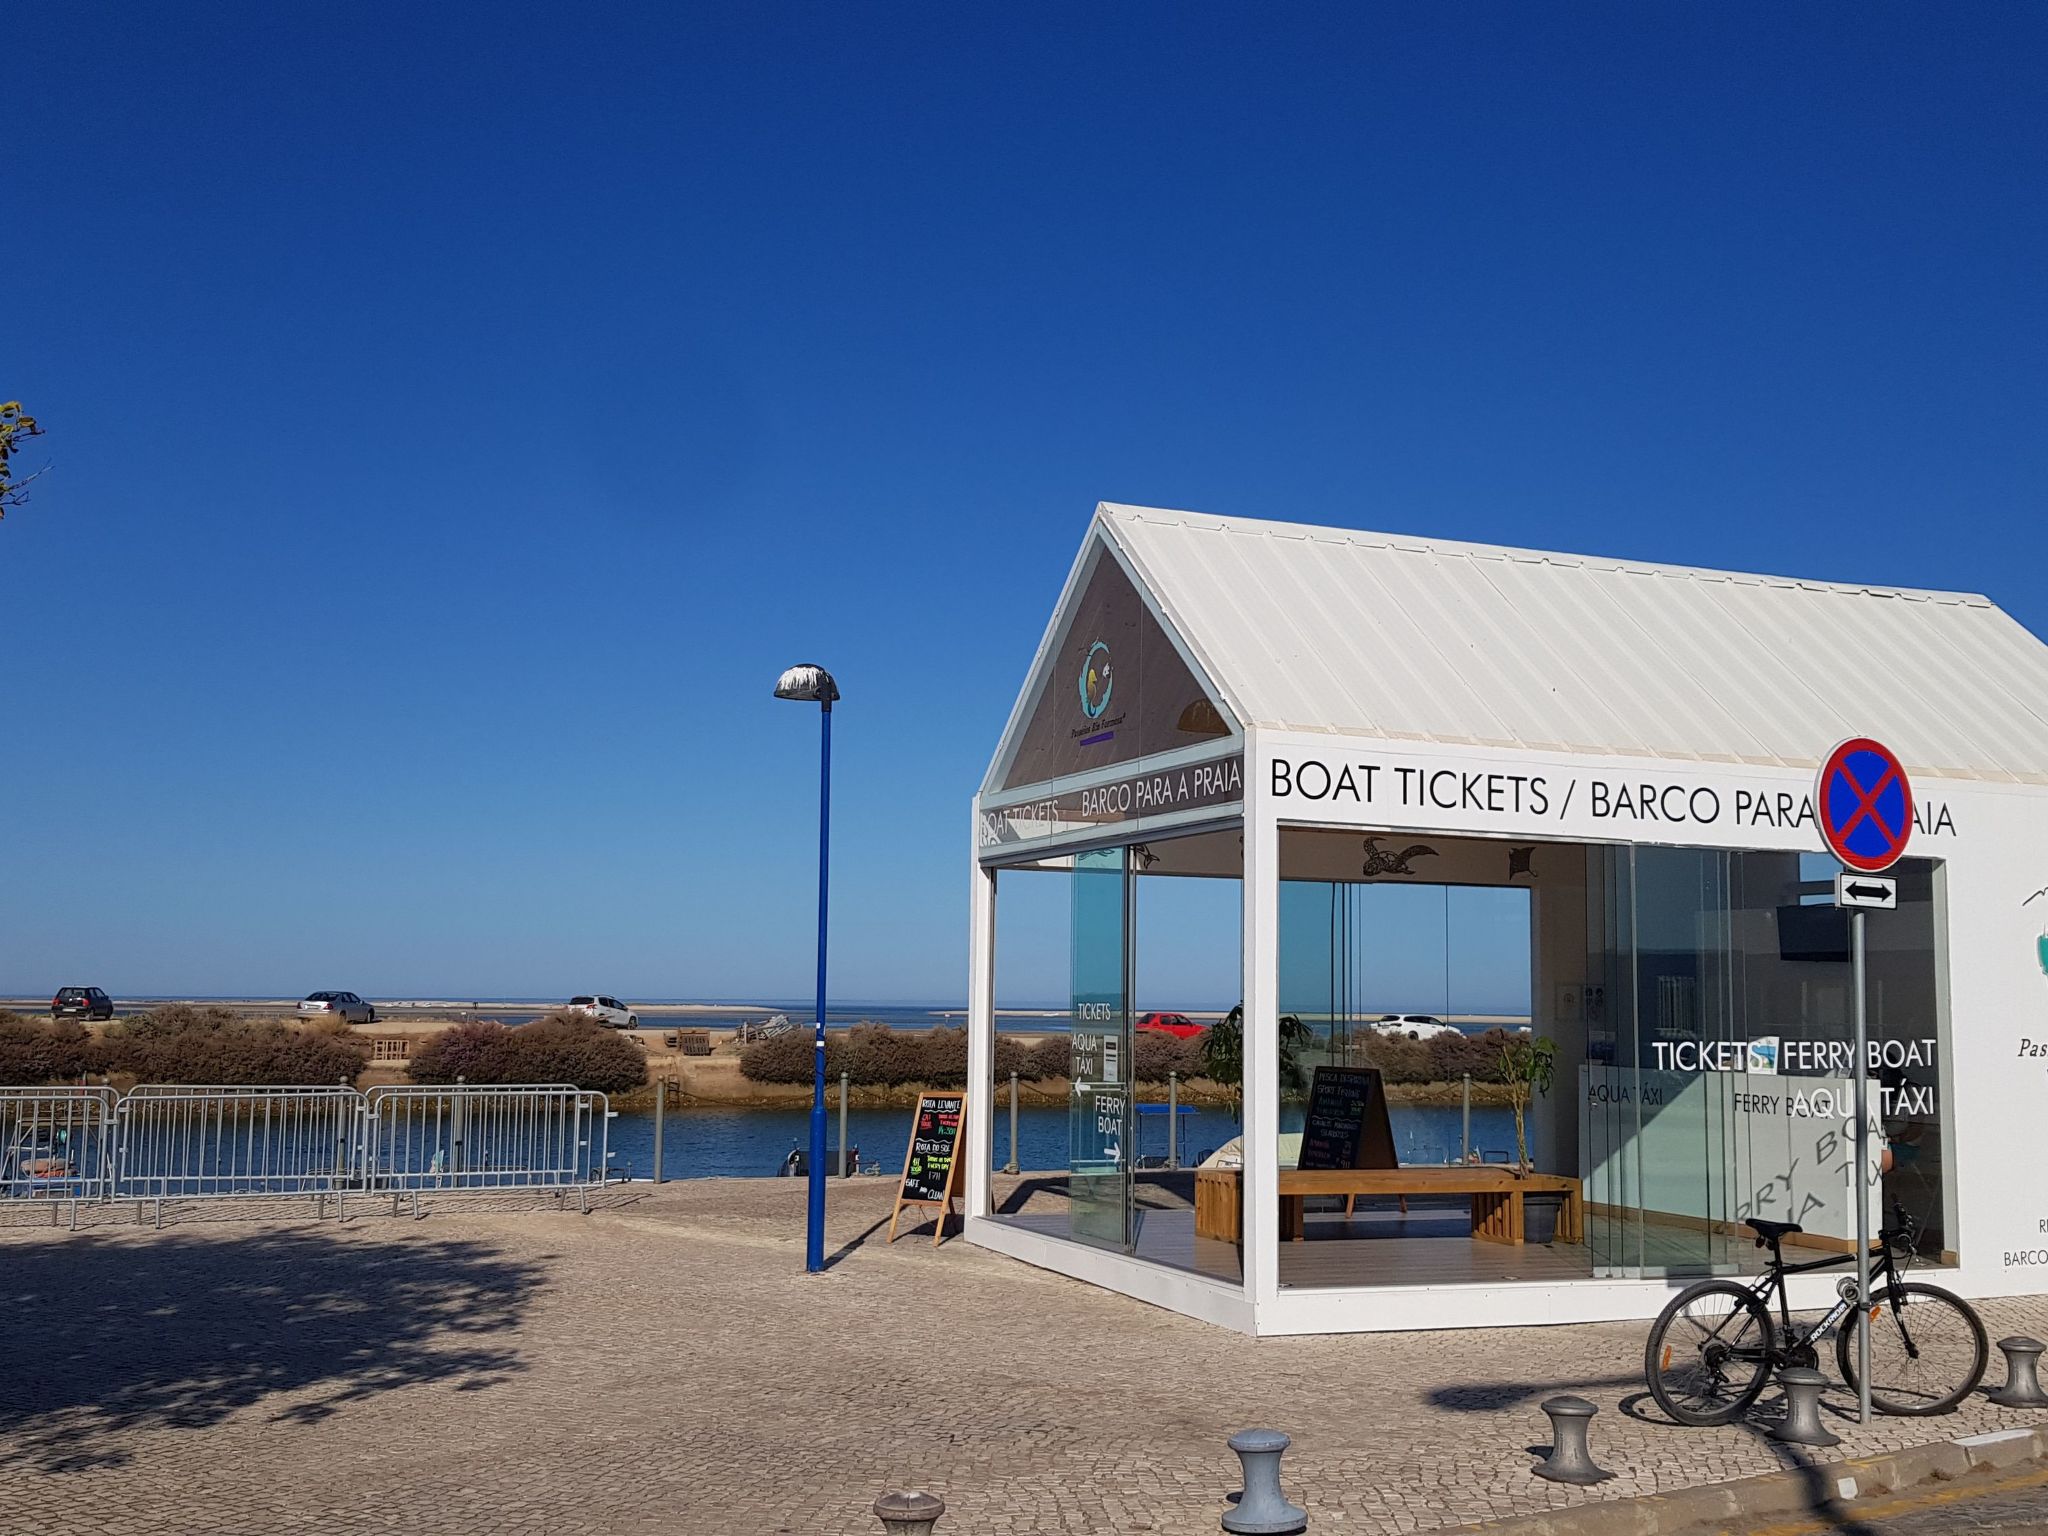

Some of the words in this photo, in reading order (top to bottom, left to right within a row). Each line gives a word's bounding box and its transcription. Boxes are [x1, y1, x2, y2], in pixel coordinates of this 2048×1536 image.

[1013, 799, 1059, 830] TICKETS
[1082, 783, 1131, 817] BARCO
[1136, 775, 1173, 809] PARA
[1177, 772, 1189, 802] A
[1194, 759, 1242, 798] PRAIA
[1272, 758, 1381, 803] BOAT
[1394, 767, 1550, 815] TICKETS
[1592, 781, 1720, 824] BARCO
[1736, 789, 1819, 830] PARA
[1078, 1002, 1111, 1021] TICKETS
[1072, 1033, 1098, 1052] AQUA
[1652, 1041, 1763, 1071] TICKETS
[1783, 1041, 1856, 1070] FERRY
[1868, 1039, 1937, 1069] BOAT
[1588, 1084, 1631, 1105] AQUA
[1734, 1093, 1780, 1115] FERRY
[1880, 1078, 1935, 1116] TÁXI
[1095, 1095, 1126, 1116] FERRY
[1098, 1115, 1122, 1136] BOAT
[916, 1142, 931, 1152] ROTA
